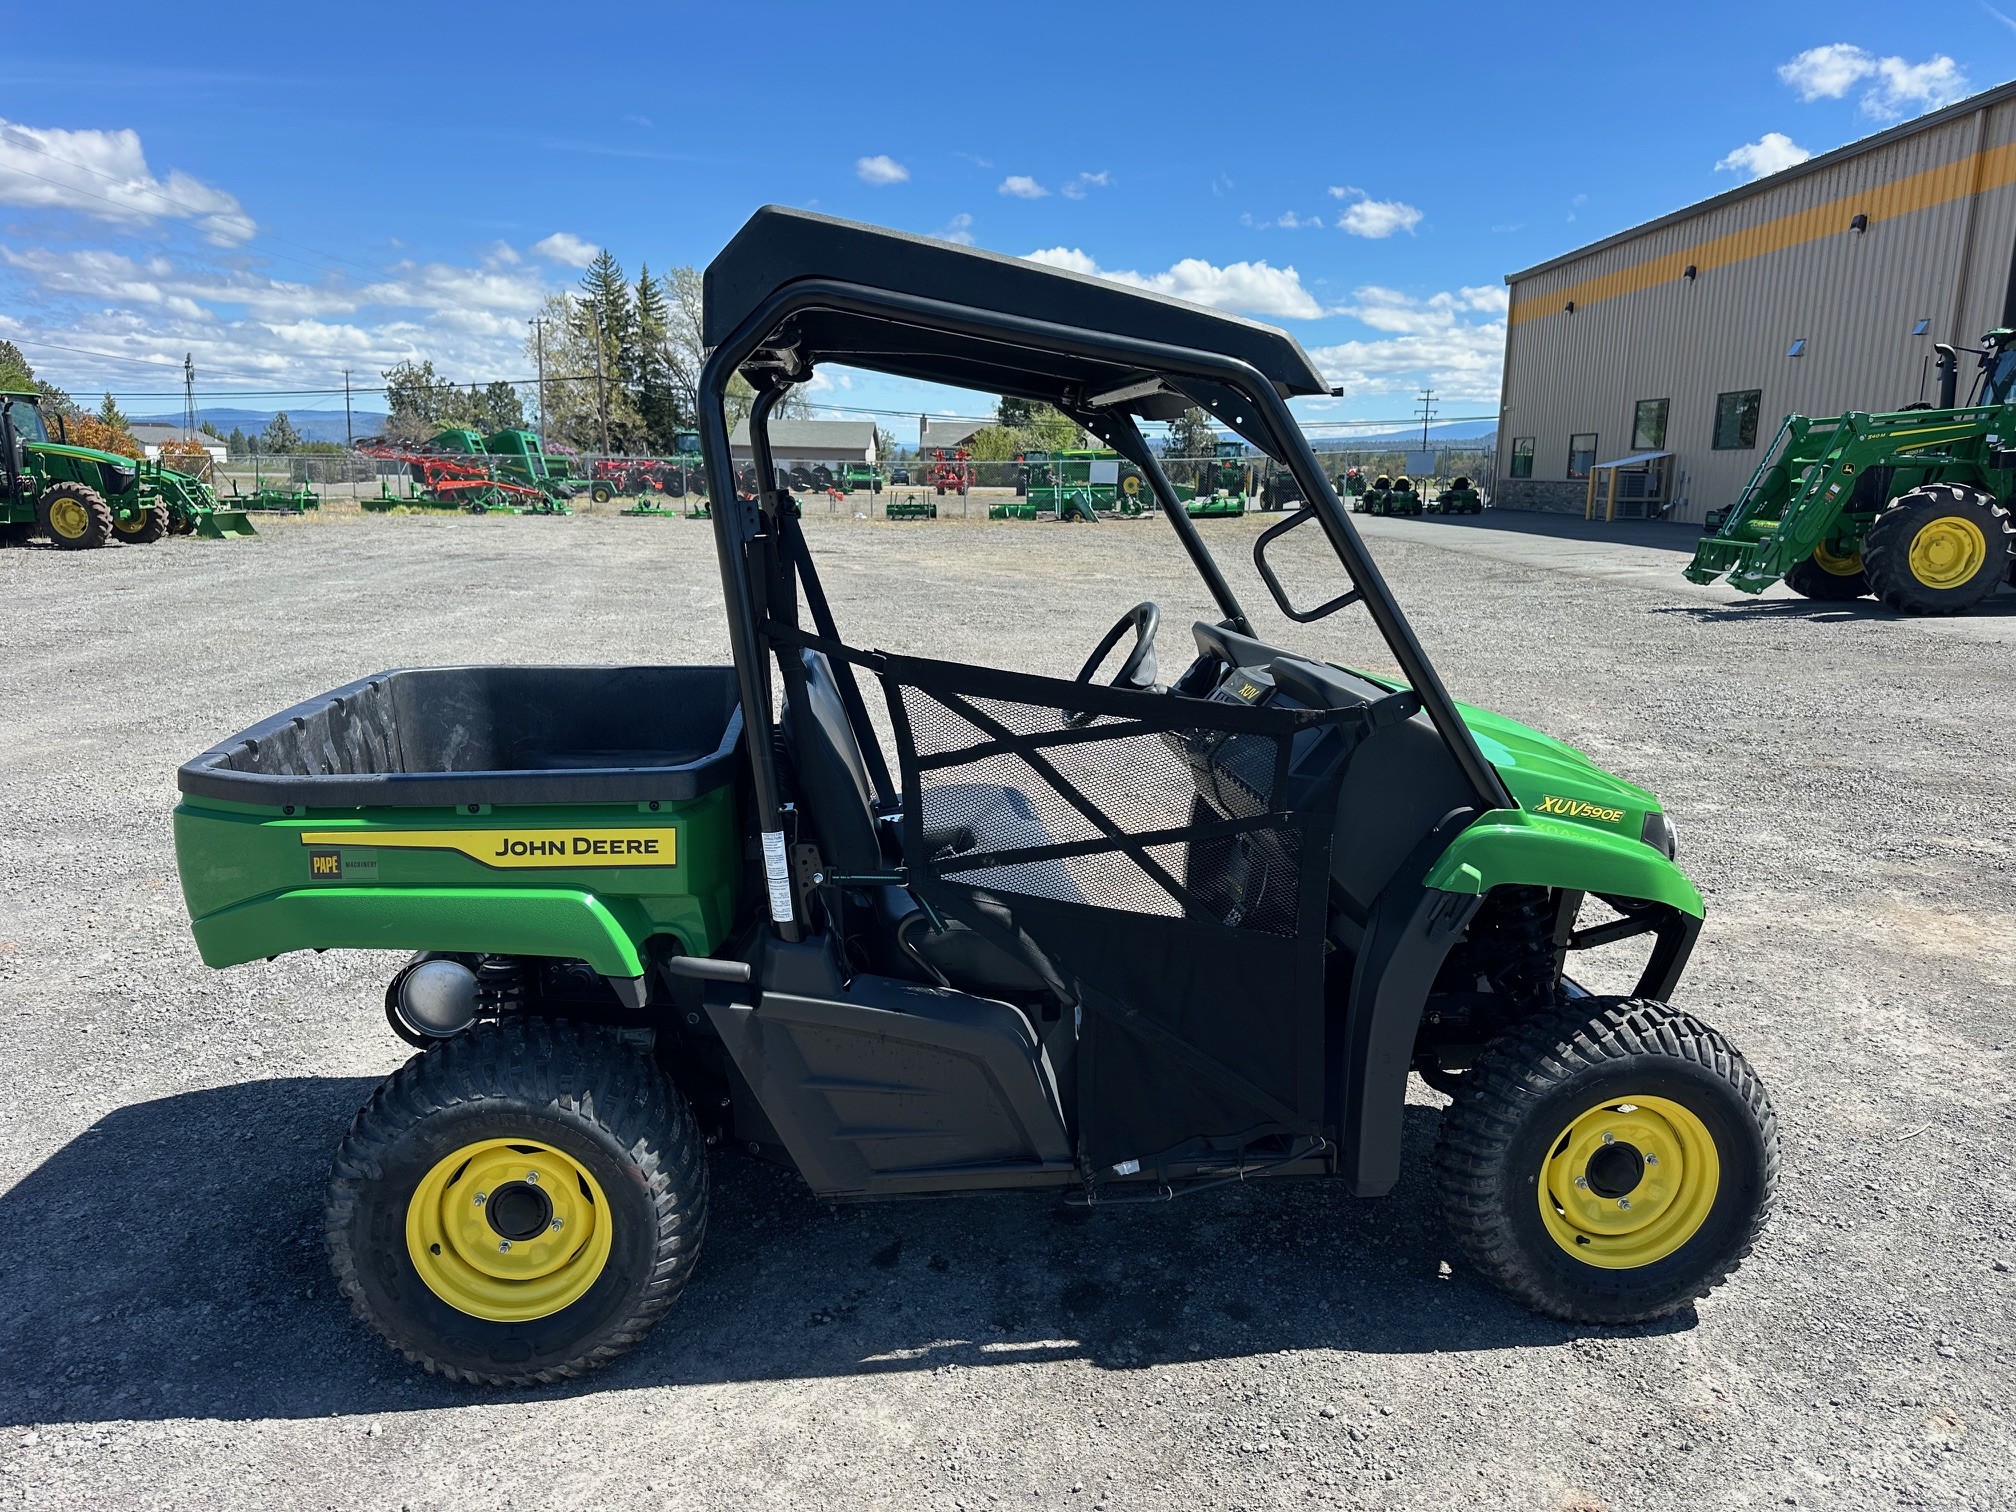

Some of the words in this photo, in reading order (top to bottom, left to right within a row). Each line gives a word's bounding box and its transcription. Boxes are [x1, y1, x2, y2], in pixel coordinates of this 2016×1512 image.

[1238, 683, 1260, 700] XUV
[1536, 796, 1624, 822] XUV590E
[495, 838, 565, 857] JOHN
[572, 837, 659, 855] DEERE
